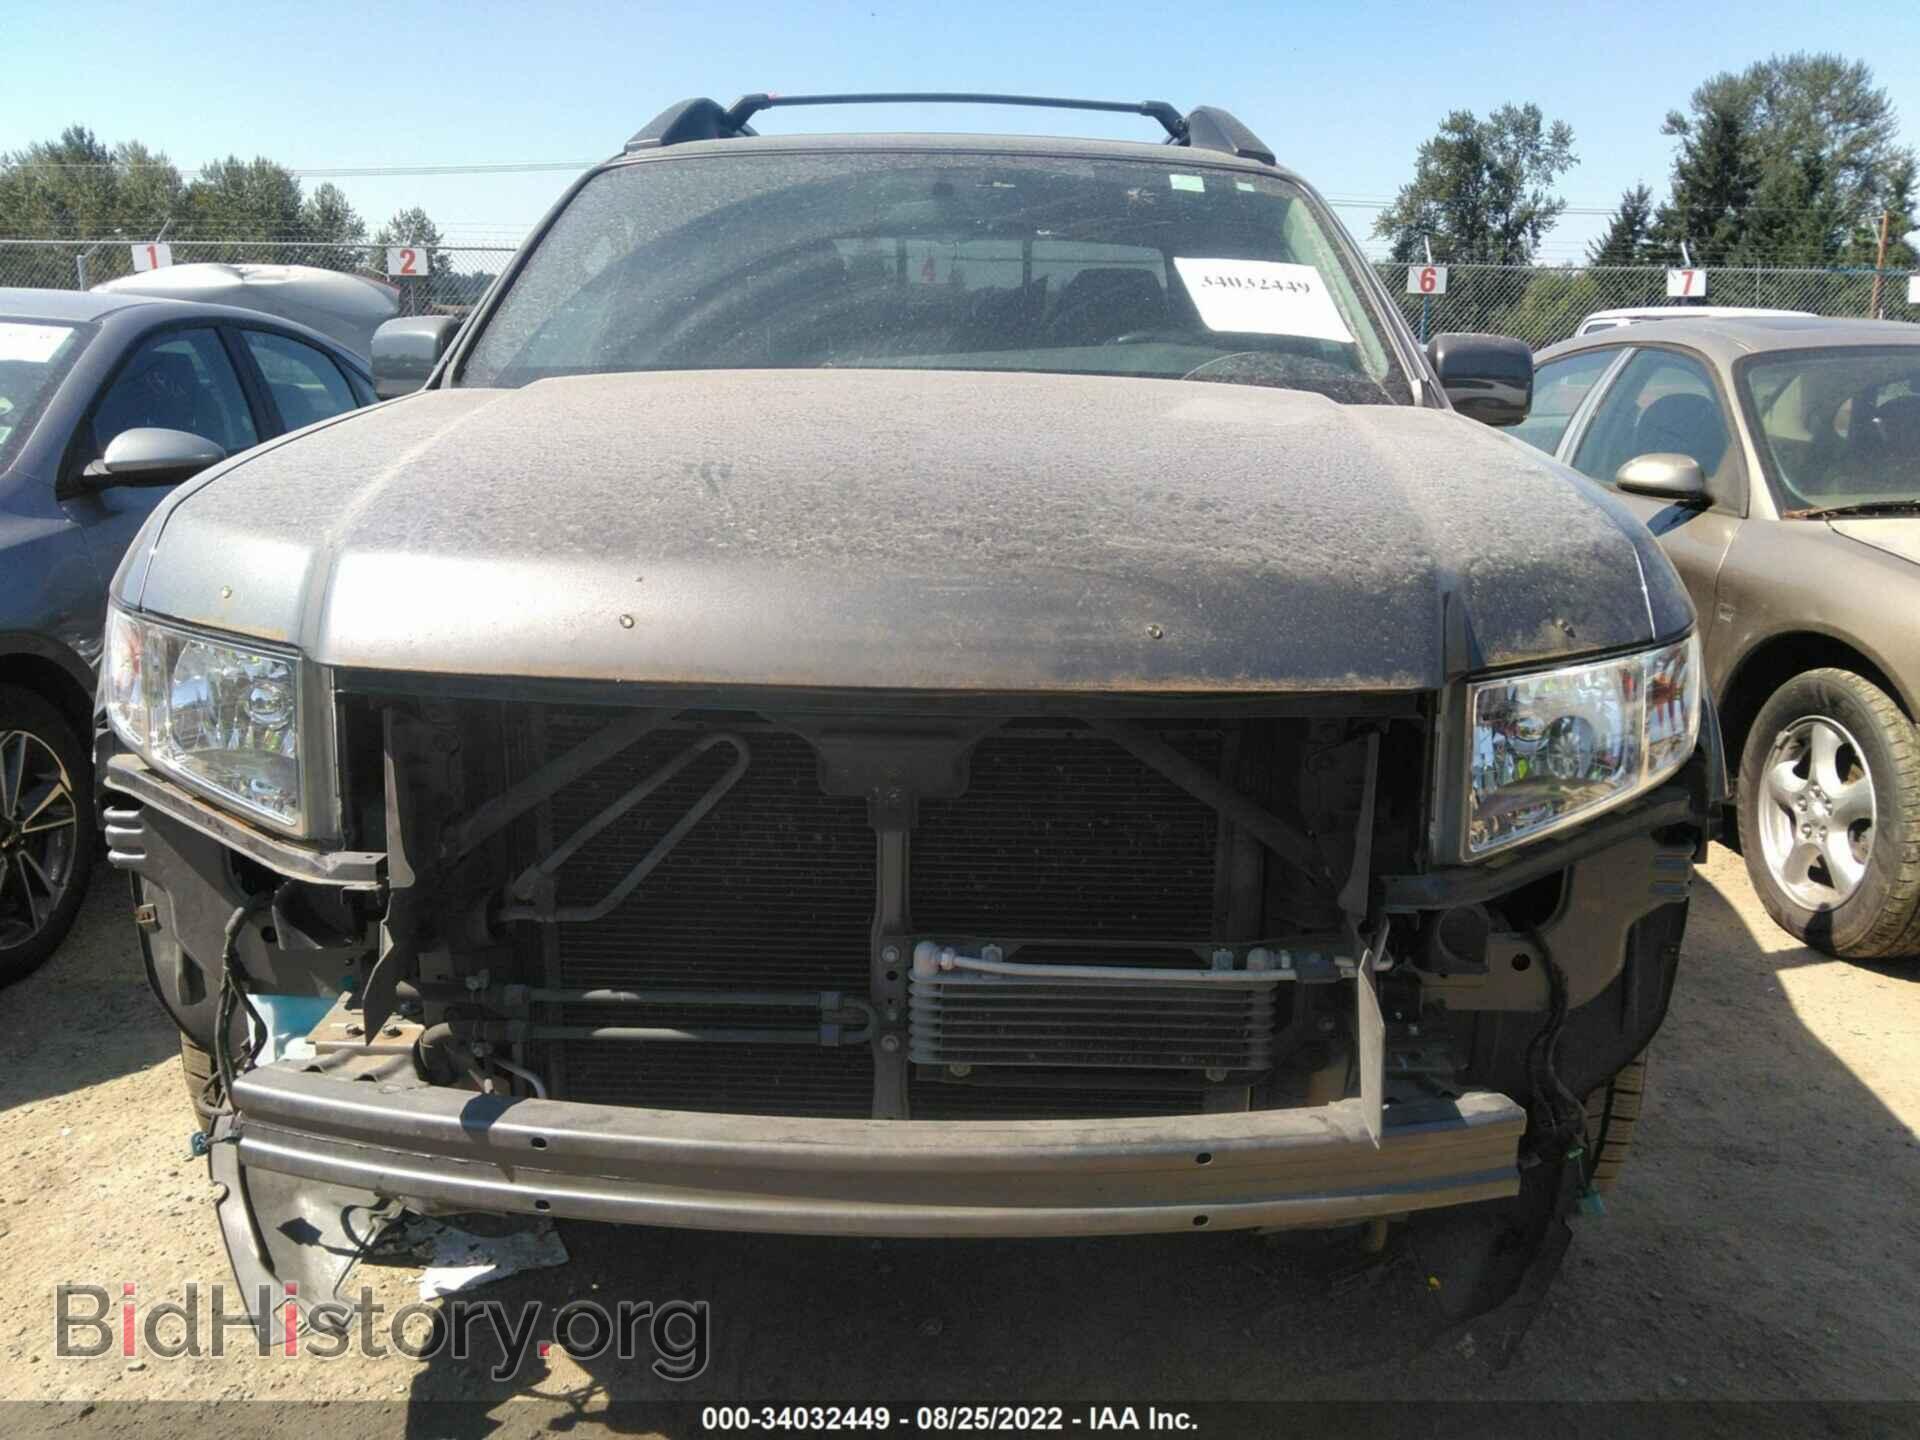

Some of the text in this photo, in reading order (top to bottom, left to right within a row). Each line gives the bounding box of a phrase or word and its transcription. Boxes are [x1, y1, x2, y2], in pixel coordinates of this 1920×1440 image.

[146, 245, 158, 270] 1
[400, 249, 416, 274] 2
[1420, 267, 1436, 292] 6
[1681, 270, 1695, 296] 7
